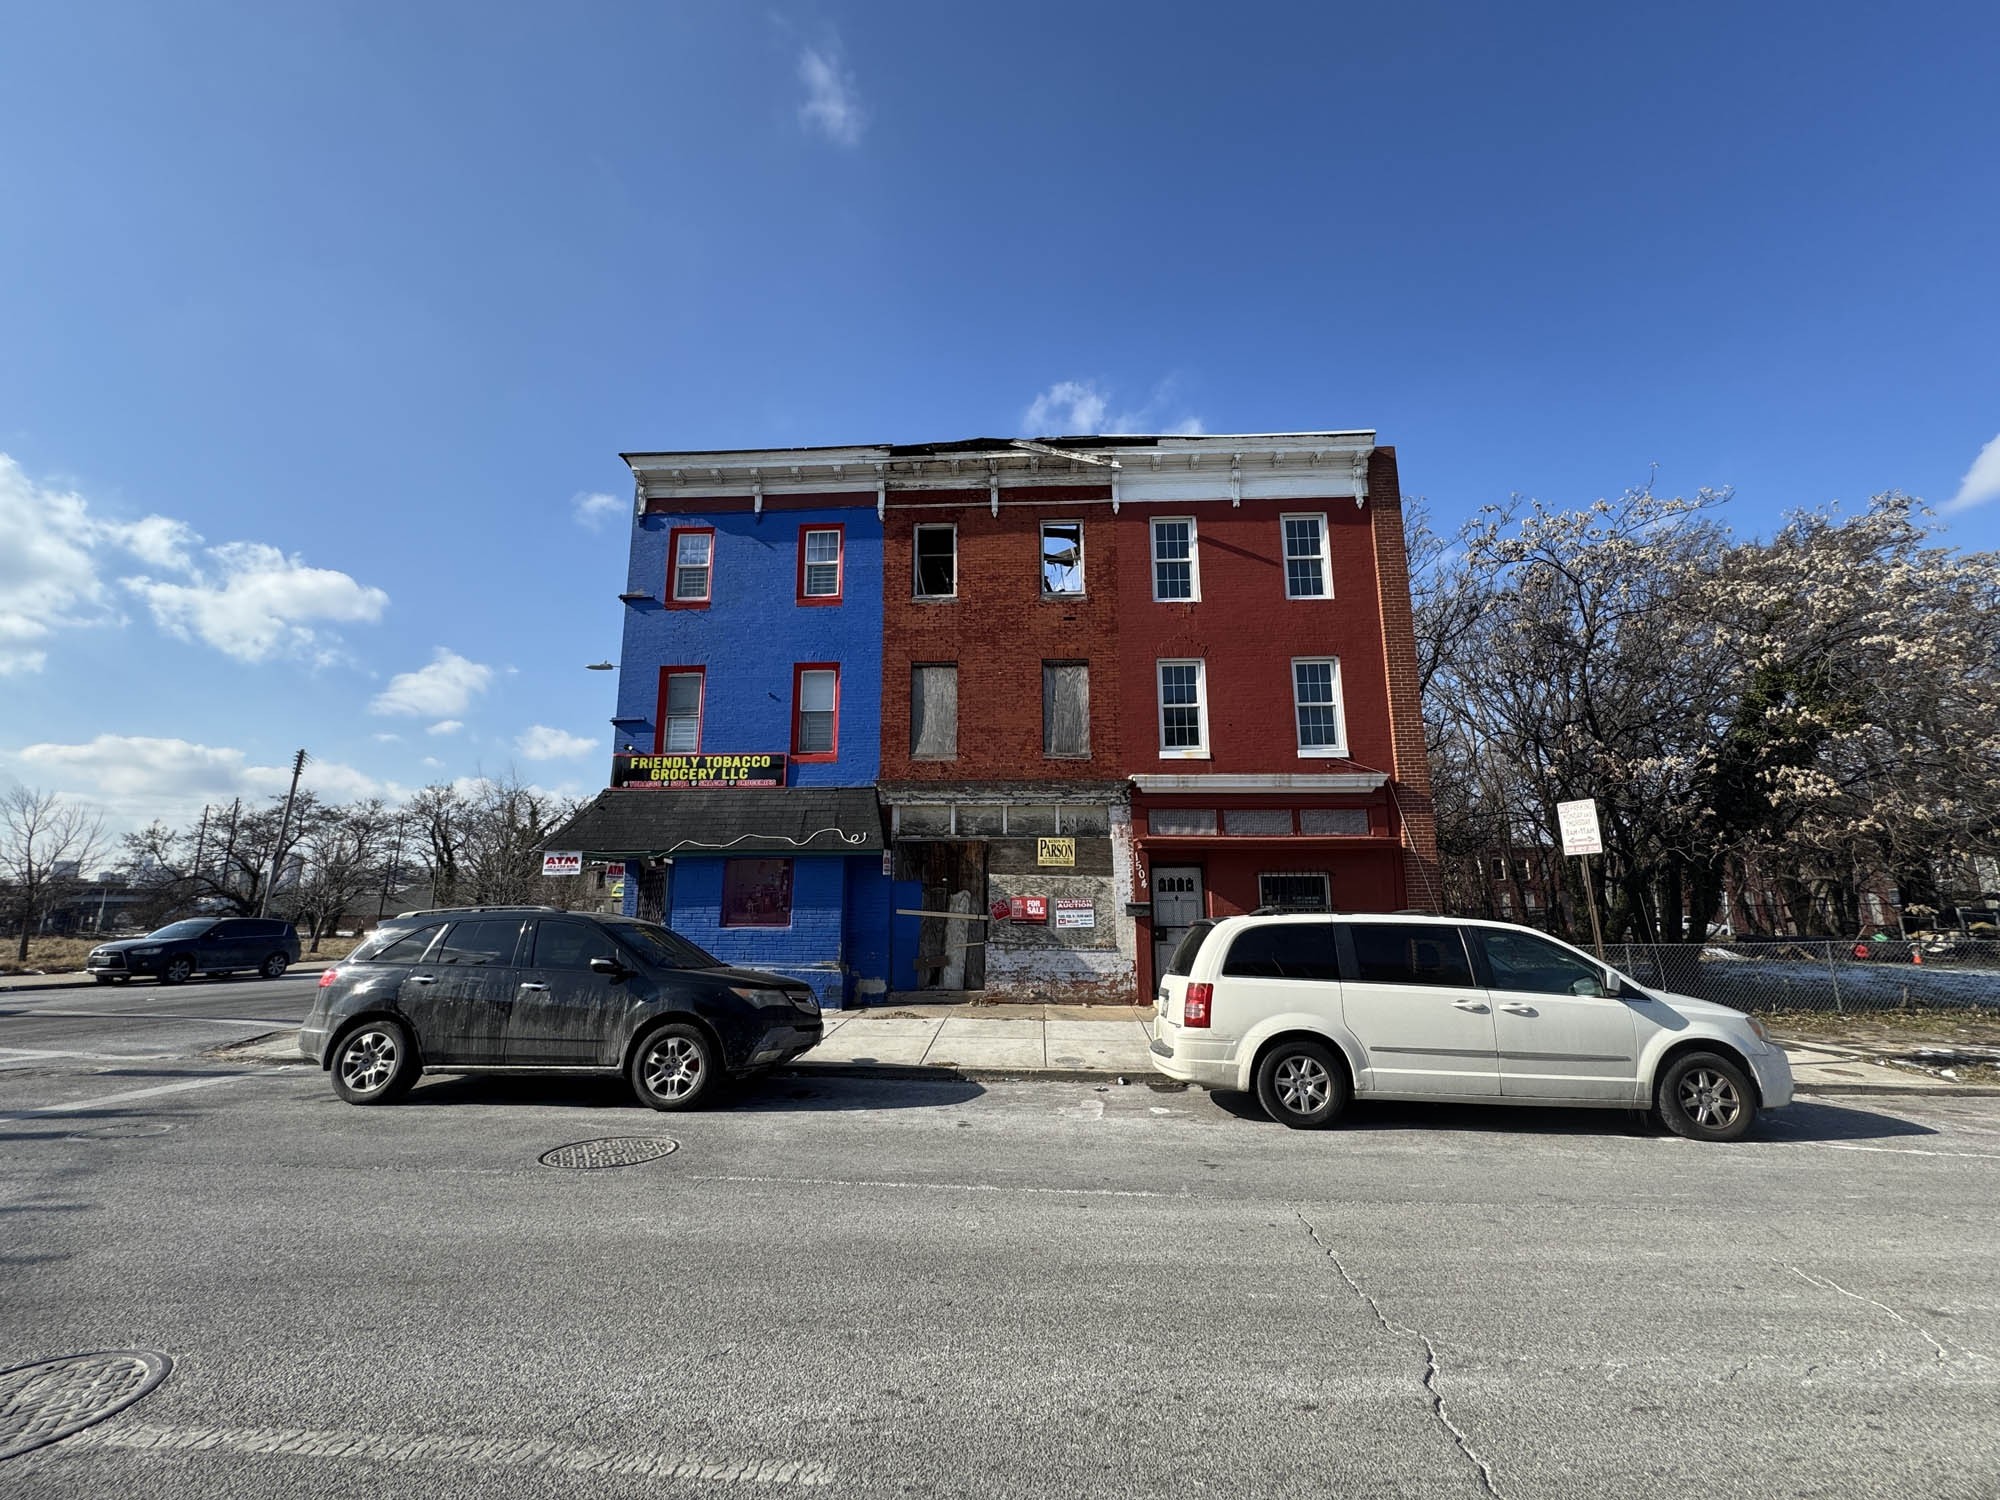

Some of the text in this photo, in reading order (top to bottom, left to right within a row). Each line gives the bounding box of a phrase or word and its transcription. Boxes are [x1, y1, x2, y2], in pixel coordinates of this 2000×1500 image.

[630, 756, 771, 769] FRIENDLY TOBACCO
[650, 768, 749, 780] GROCERY LLC
[1040, 840, 1073, 857] PARSON
[545, 856, 579, 864] ATM
[607, 865, 624, 875] ATM
[1135, 851, 1147, 889] 1504
[1027, 906, 1045, 915] SALE
